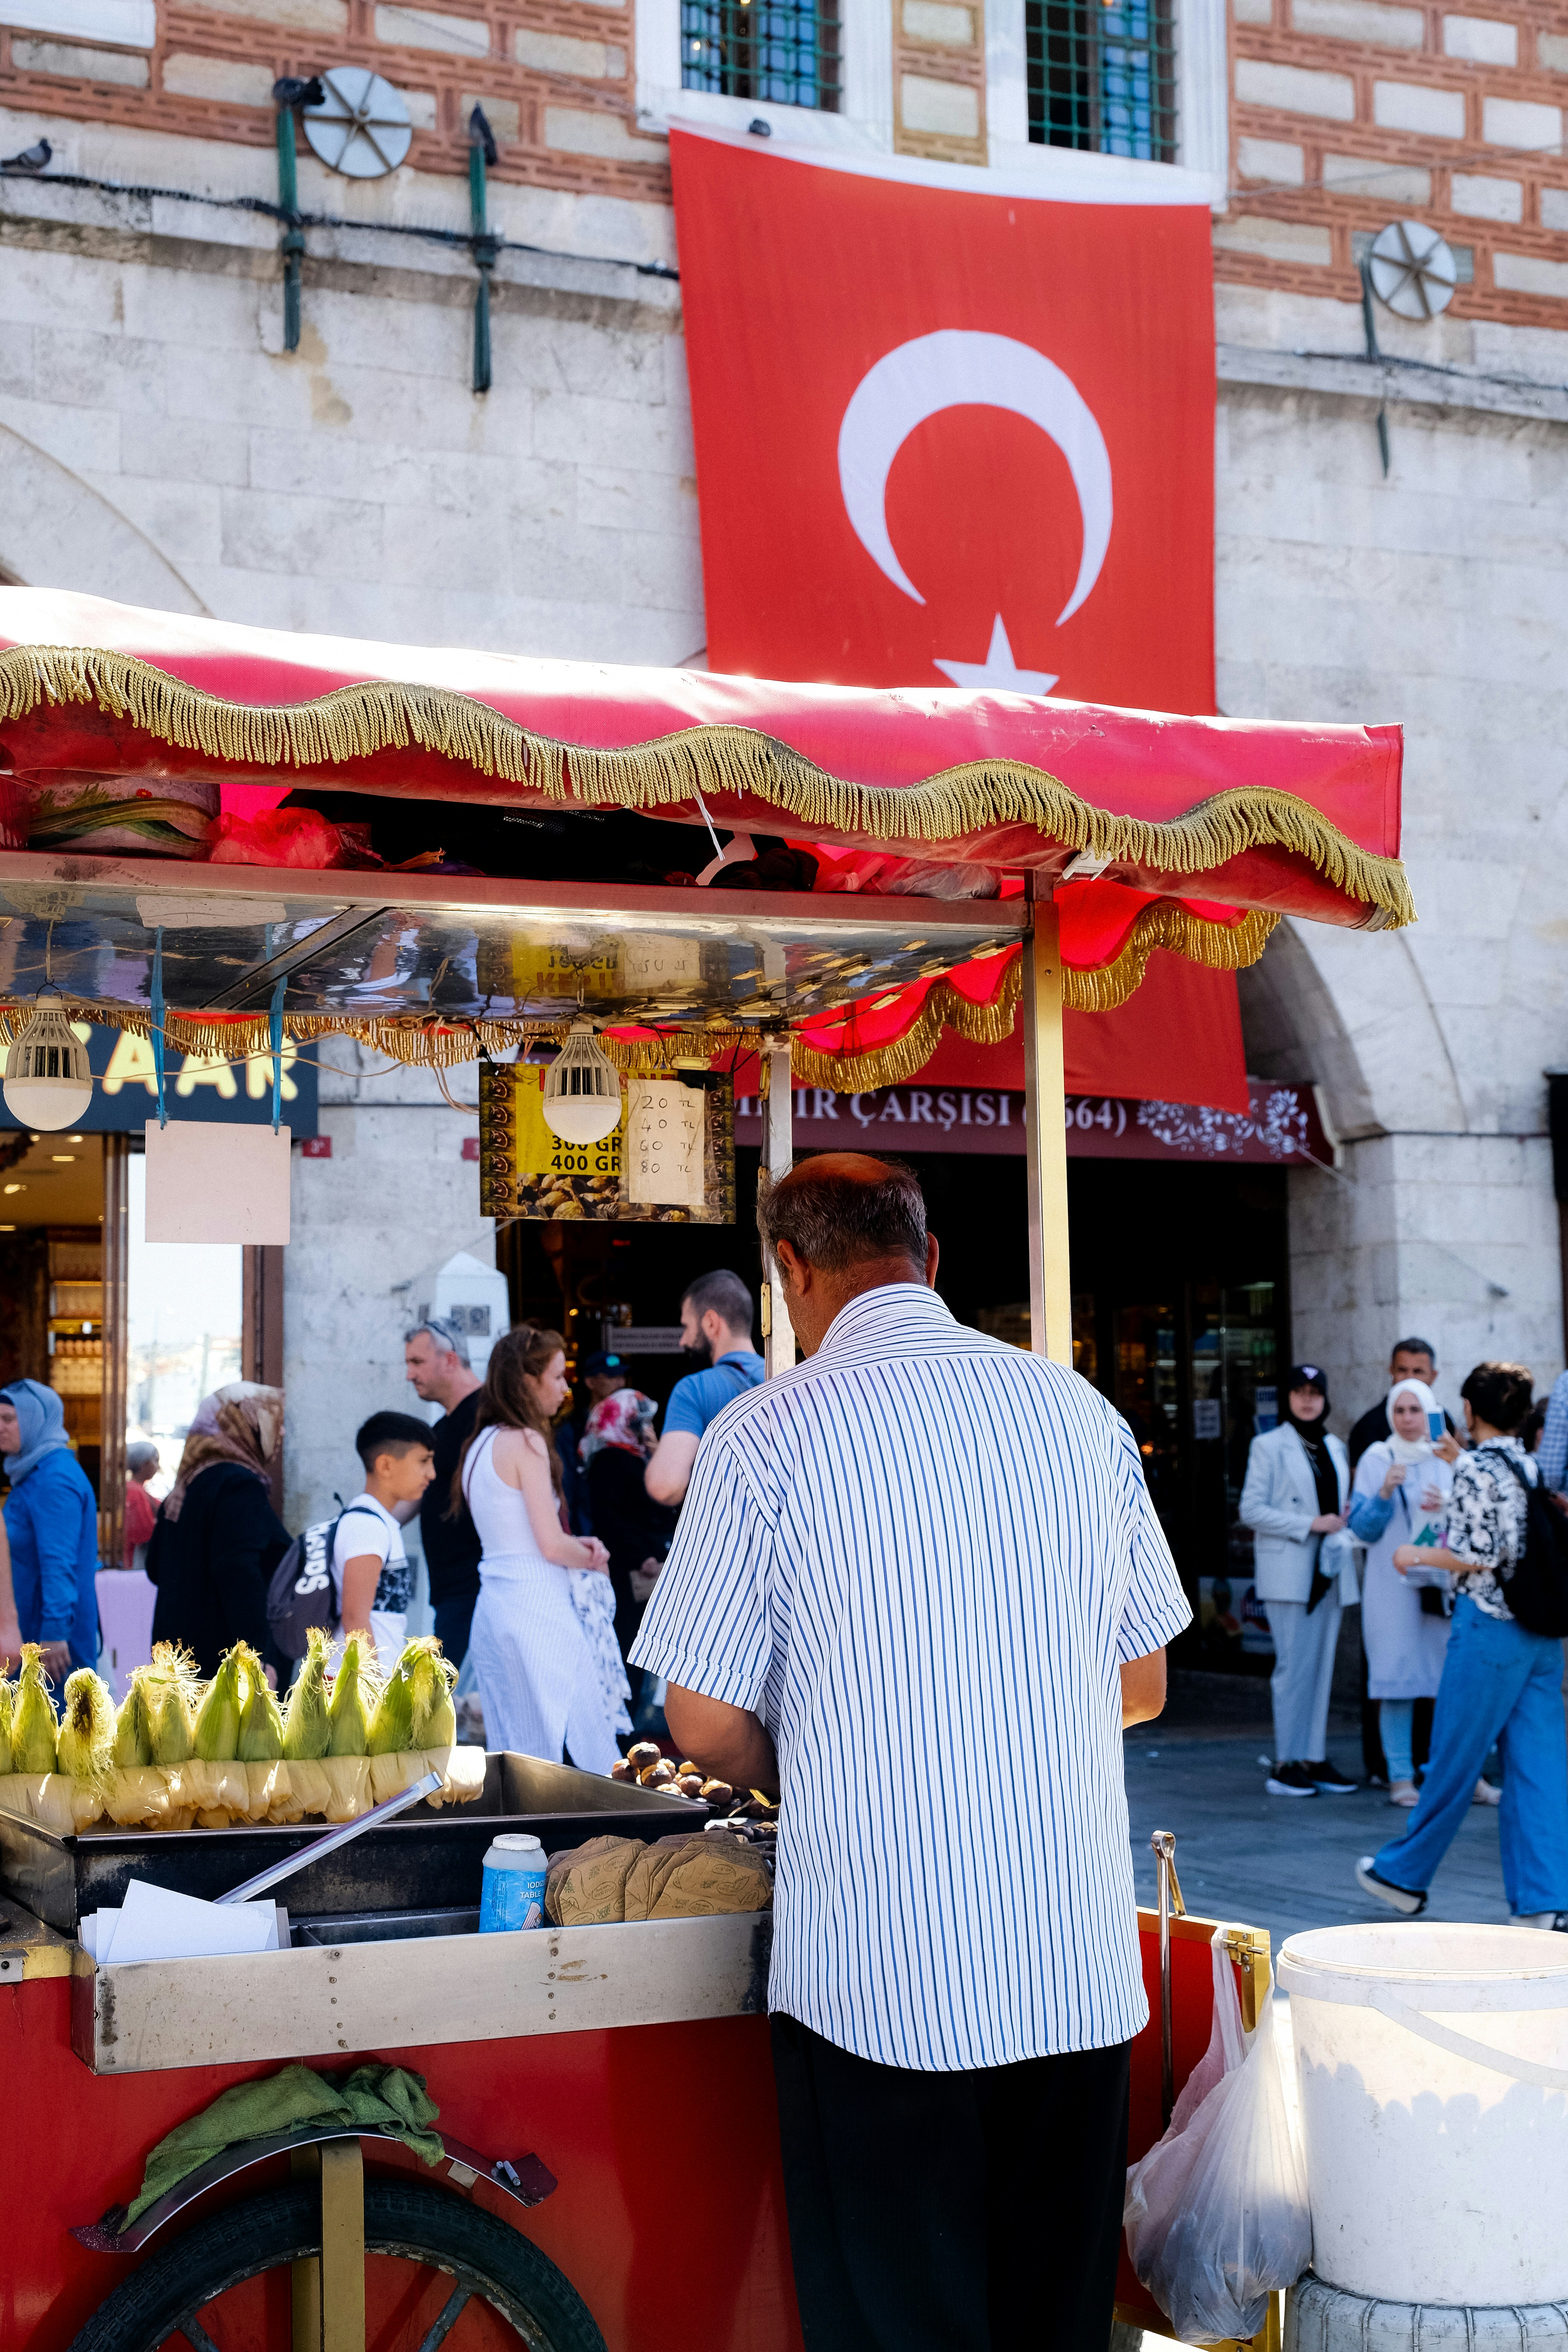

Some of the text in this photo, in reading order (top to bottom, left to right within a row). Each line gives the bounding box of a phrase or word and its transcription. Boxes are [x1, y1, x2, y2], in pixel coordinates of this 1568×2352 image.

[642, 1095, 695, 1109] 20 TL
[850, 1091, 1011, 1131] ÇARŞISI
[642, 1118, 695, 1132] 40 TL
[595, 1136, 622, 1152] GR
[640, 1139, 663, 1151] 60
[551, 1155, 621, 1171] 400 GR
[641, 1159, 660, 1173] 80
[519, 1890, 542, 1899] TABLE
